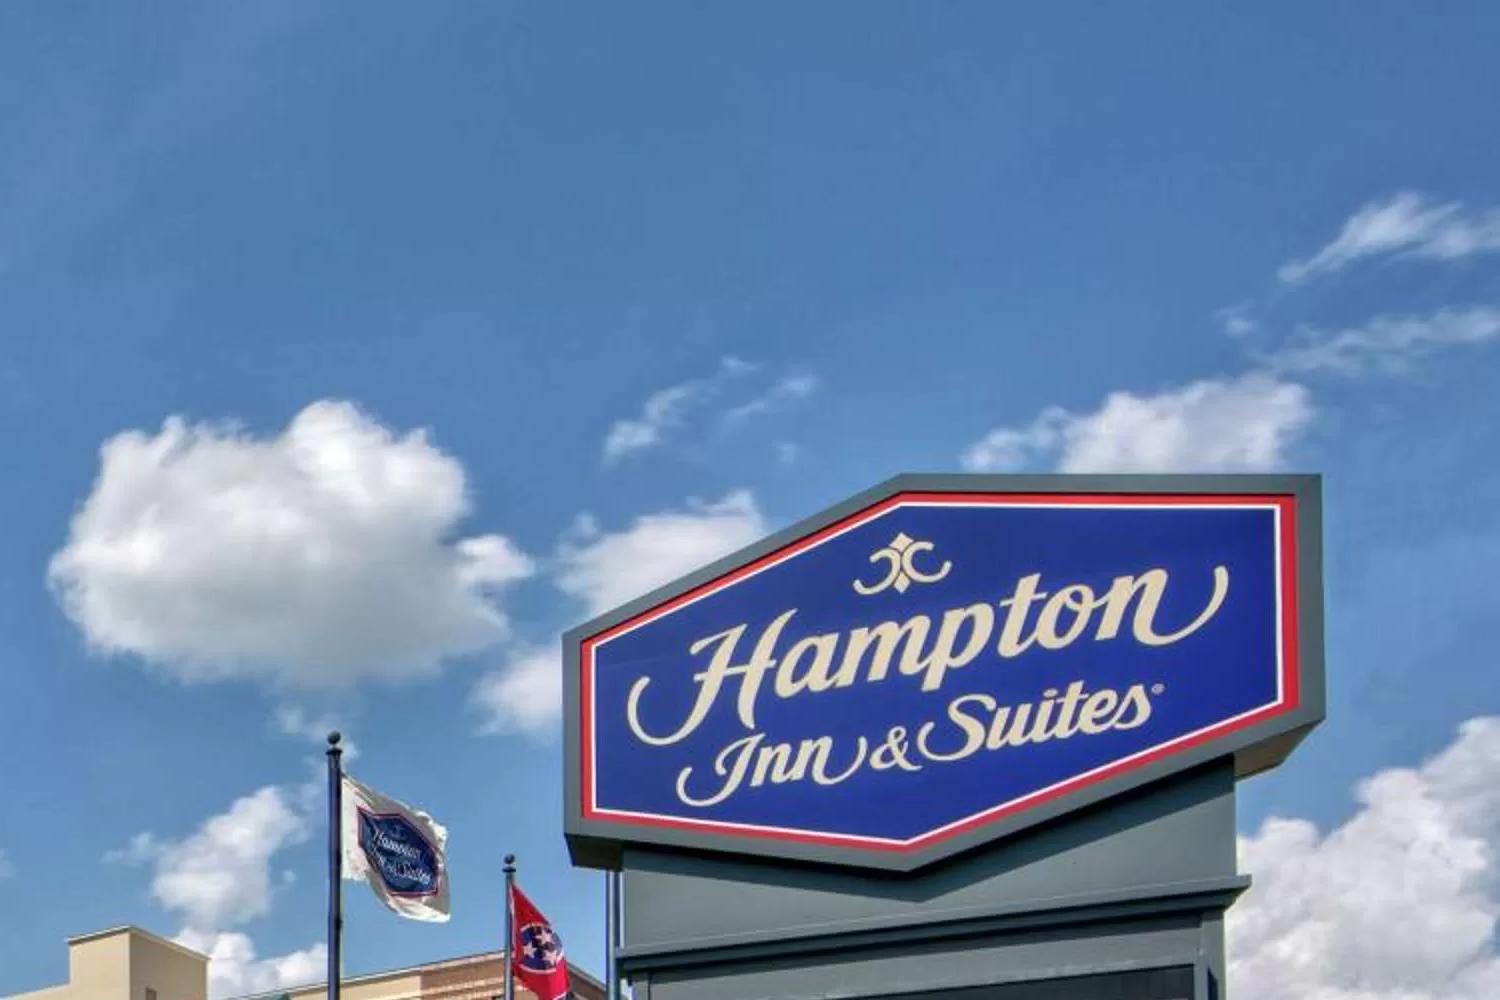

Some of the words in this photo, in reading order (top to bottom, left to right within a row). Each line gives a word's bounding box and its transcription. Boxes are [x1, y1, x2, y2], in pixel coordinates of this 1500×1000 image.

[627, 565, 1229, 746] Hampton
[676, 733, 868, 807] Inn
[869, 726, 922, 771] &
[916, 680, 1152, 761] Suites
